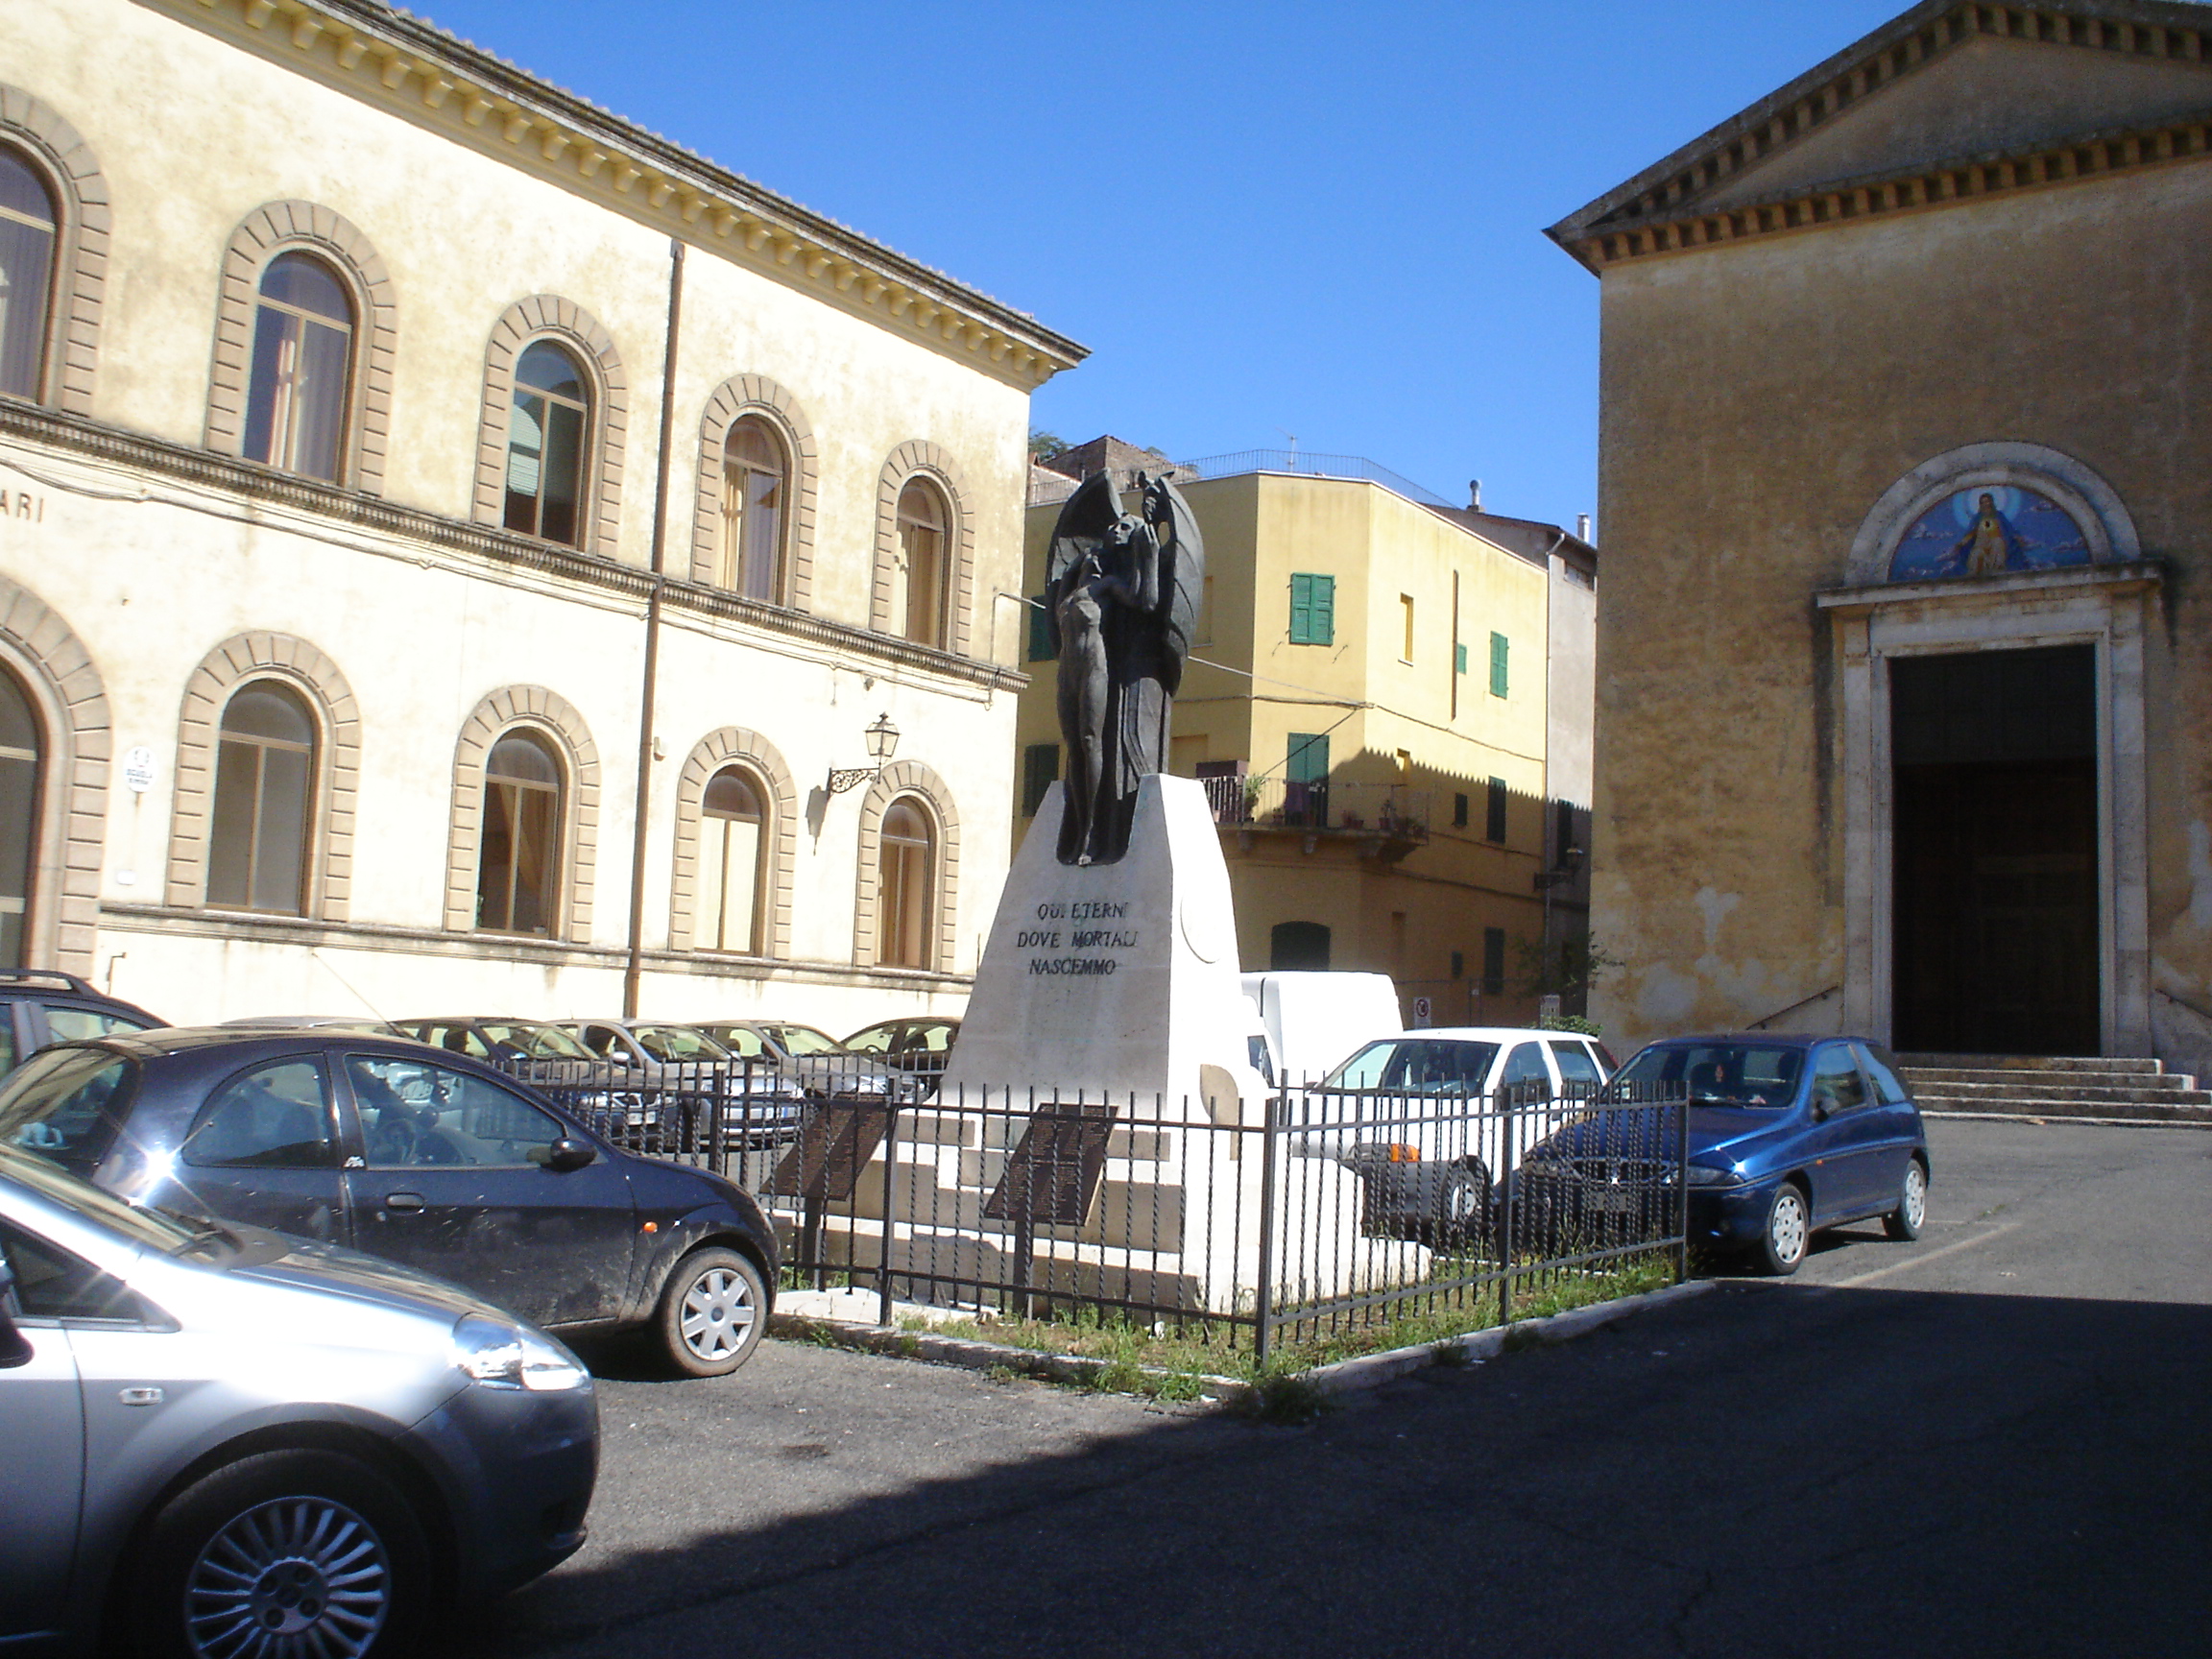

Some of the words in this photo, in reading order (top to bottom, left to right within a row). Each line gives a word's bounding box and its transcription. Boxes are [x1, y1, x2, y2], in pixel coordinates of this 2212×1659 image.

[1018, 931, 1061, 949] DOVE
[1071, 930, 1139, 950] MORTALI
[1029, 958, 1116, 975] NASCEMMO
